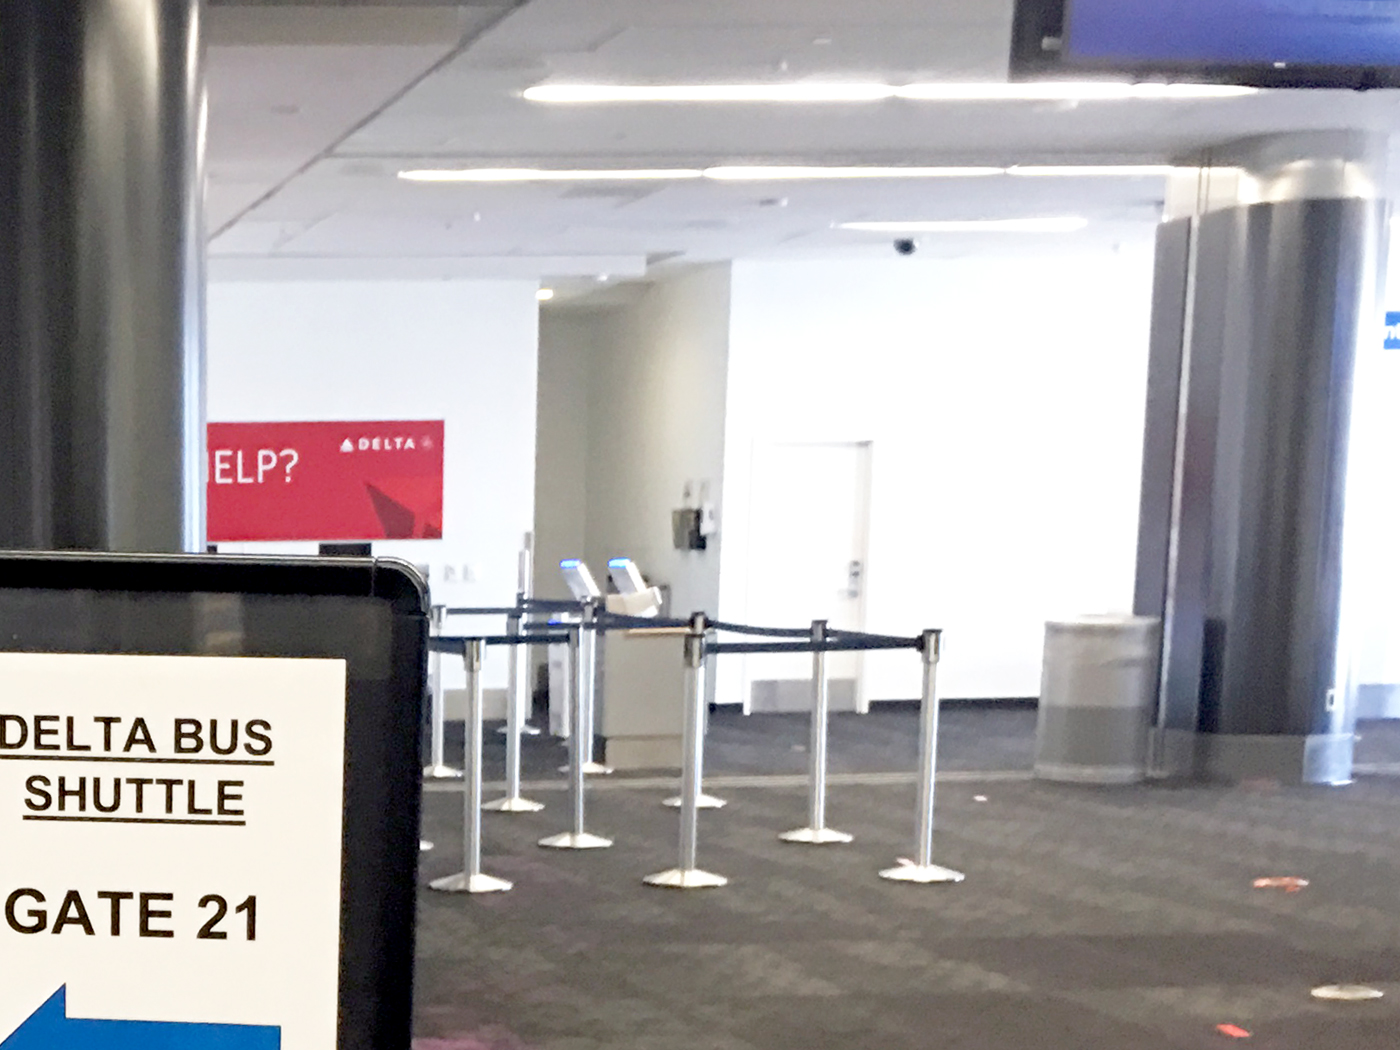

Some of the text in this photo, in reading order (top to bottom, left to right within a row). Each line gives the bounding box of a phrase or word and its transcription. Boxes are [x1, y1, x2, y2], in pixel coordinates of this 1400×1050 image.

[358, 436, 416, 451] DELTA
[206, 448, 299, 484] ELP?
[0, 714, 273, 756] DELTA BUS
[24, 774, 244, 815] SHUTTLE
[4, 888, 257, 941] GATE 21
